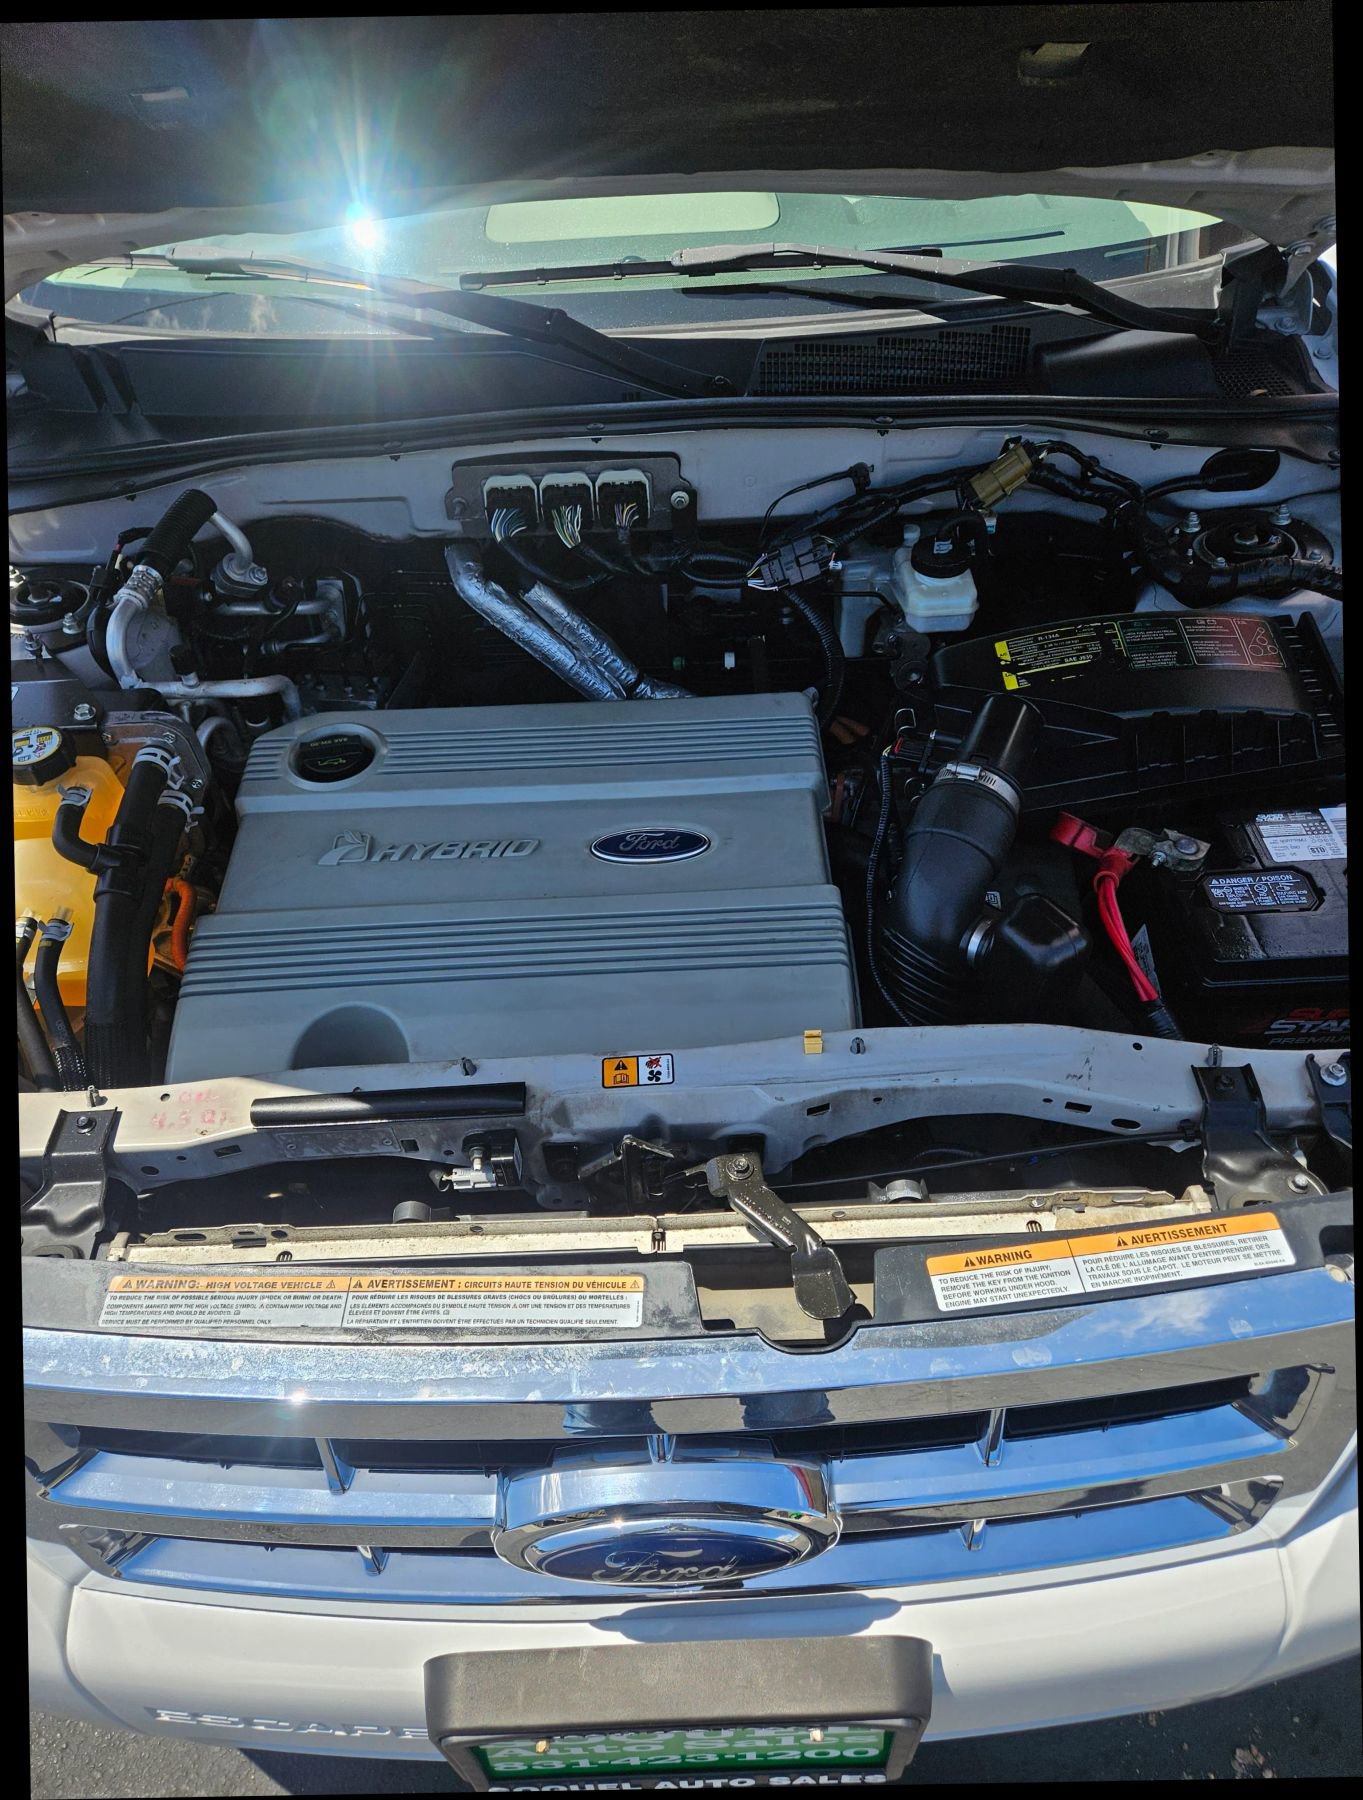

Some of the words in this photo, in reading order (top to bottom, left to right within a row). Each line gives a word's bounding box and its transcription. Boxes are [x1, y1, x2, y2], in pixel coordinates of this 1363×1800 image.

[370, 839, 540, 862] HYBRID
[619, 831, 680, 852] Ford
[1262, 874, 1293, 882] POISON
[1131, 1223, 1228, 1246] AVERTISSEMENT
[976, 1250, 1033, 1266] WARNING
[1082, 1257, 1103, 1266] POUR
[1104, 1253, 1136, 1263] RÉDUIRE
[1151, 1246, 1181, 1256] RISQUES
[1194, 1239, 1236, 1250] BLESSURES,
[1238, 1235, 1268, 1244] RETIRER
[950, 1274, 978, 1284] REDUCE
[980, 1272, 994, 1280] THE
[996, 1269, 1012, 1278] RISK
[1024, 1265, 1052, 1273] INJURY:
[1088, 1272, 1120, 1281] TRAVAUX
[1122, 1268, 1140, 1276] SOUS
[1152, 1264, 1179, 1272] CAPOT.
[1192, 1257, 1222, 1267] MOTEUR
[1222, 1254, 1242, 1262] PEUT
[1242, 1252, 1252, 1260] SE
[1252, 1249, 1282, 1258] METTRE
[136, 1280, 200, 1289] WARNING:
[367, 1280, 456, 1288] AVERTISSEMENT
[586, 1280, 626, 1288] VÉHICULE
[940, 1284, 970, 1293] REMOVE
[972, 1282, 986, 1290] THE
[1003, 1276, 1024, 1285] FROM
[1025, 1274, 1039, 1282] THE
[1040, 1270, 1071, 1280] IGNITION
[942, 1292, 972, 1301] BEFORE
[973, 1286, 1008, 1297] WORKING
[1008, 1283, 1033, 1292] UNDER
[1034, 1280, 1058, 1289] HOOD.
[945, 1299, 972, 1308] ENGINE
[973, 1297, 988, 1305] MAY
[990, 1294, 1012, 1302] START
[1014, 1286, 1070, 1299] UNEXPECTEDLY.
[592, 1549, 743, 1583] Ford
[488, 1743, 665, 1758] Auto
[683, 1734, 879, 1750] Sales
[654, 1777, 756, 1790] AUTO
[768, 1774, 887, 1786] SALES
